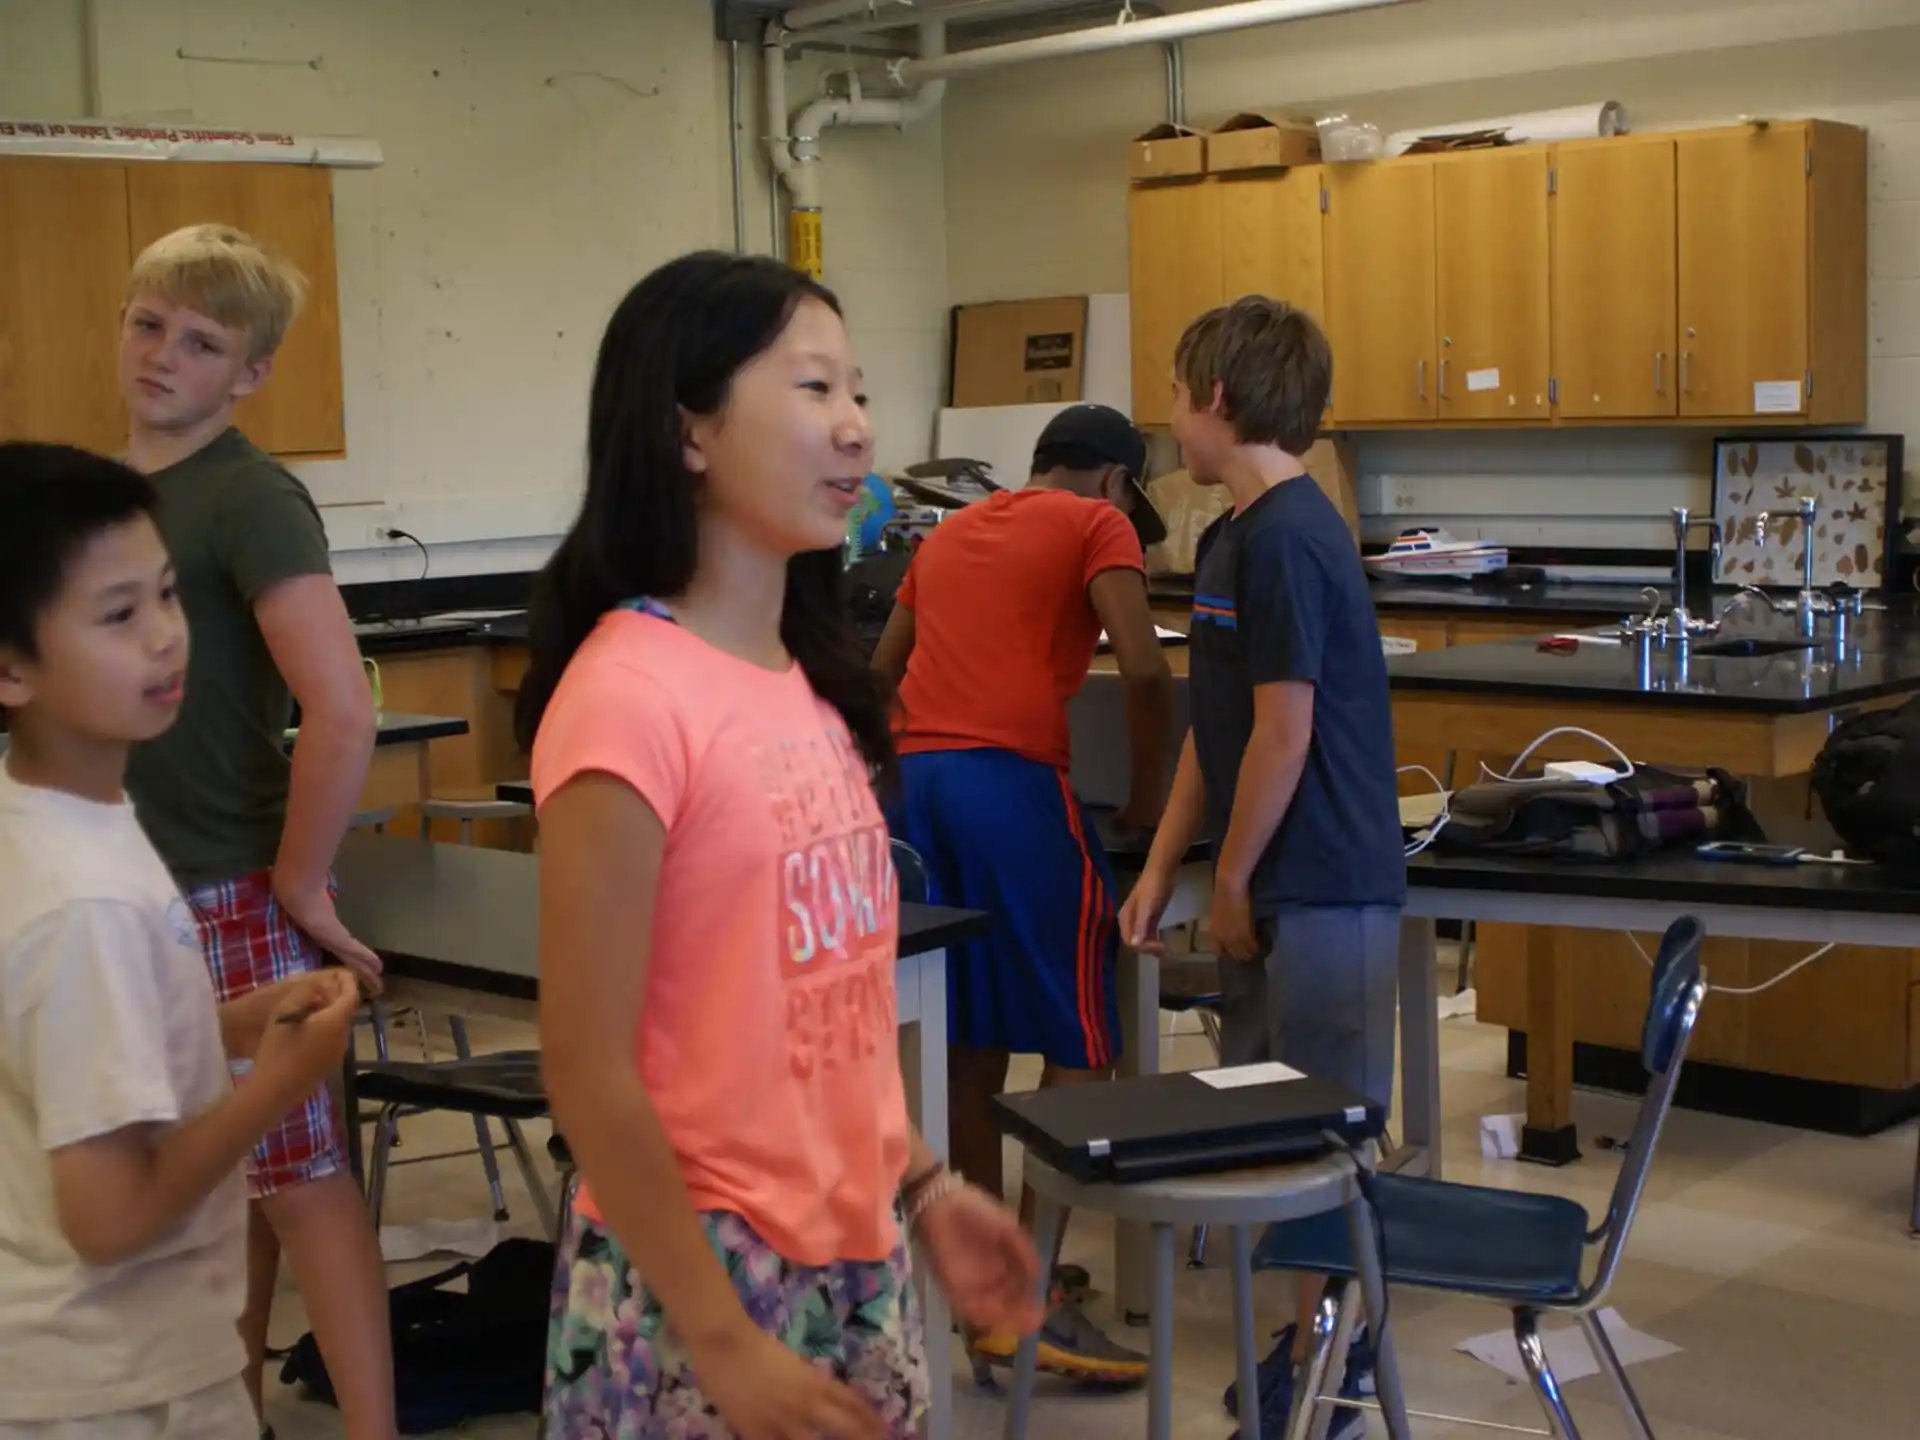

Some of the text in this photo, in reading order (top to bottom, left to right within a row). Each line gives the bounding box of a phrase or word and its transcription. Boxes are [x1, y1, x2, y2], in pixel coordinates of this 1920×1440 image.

[17, 121, 46, 137] the
[47, 122, 66, 137] of
[67, 124, 112, 140] Table
[113, 126, 179, 143] Periodic
[180, 129, 255, 146] Scientific
